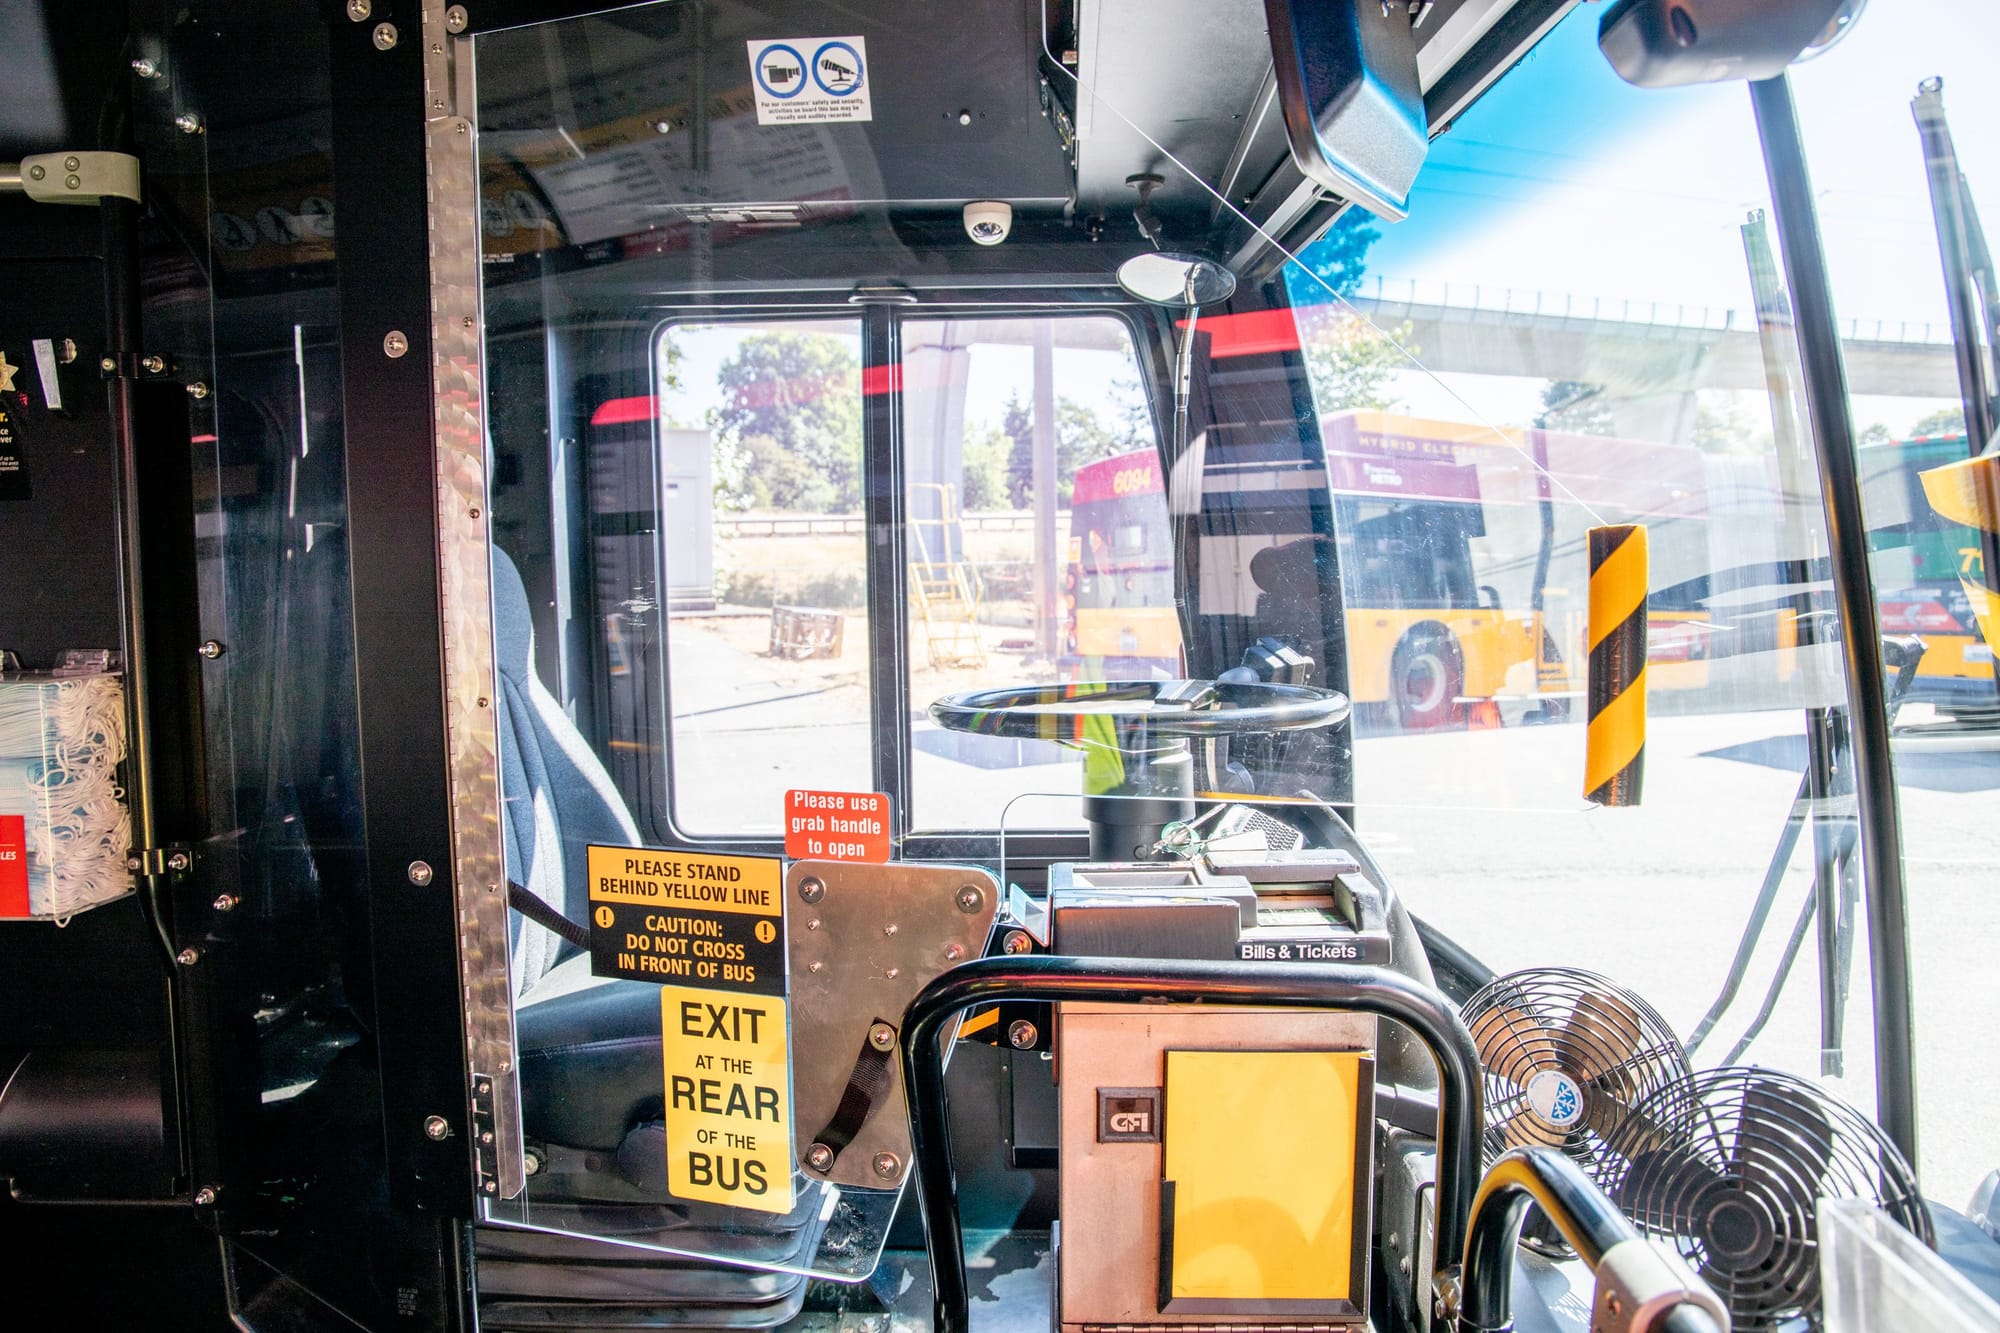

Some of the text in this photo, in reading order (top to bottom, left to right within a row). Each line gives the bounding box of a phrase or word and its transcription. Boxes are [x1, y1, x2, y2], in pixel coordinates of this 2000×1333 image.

[1113, 466, 1152, 494] 6094
[794, 792, 878, 811] Please use
[792, 816, 880, 834] grab handle
[0, 851, 16, 861] LES
[808, 838, 864, 858] to open
[625, 859, 740, 882] PLEASE STAND
[600, 878, 770, 906] BEHIND YELLOW LINE
[645, 915, 723, 938] CAUTION:
[626, 934, 745, 960] DO NOT CROSS
[1242, 944, 1357, 959] Bills & Tickets
[618, 953, 756, 982] IN FRONT OF BUS
[681, 1001, 766, 1044] EXIT
[696, 1054, 752, 1074] AT THE
[672, 1074, 780, 1122] REAR
[1110, 1112, 1149, 1132] GFI
[696, 1129, 756, 1150] OF THE
[689, 1151, 768, 1195] BUS
